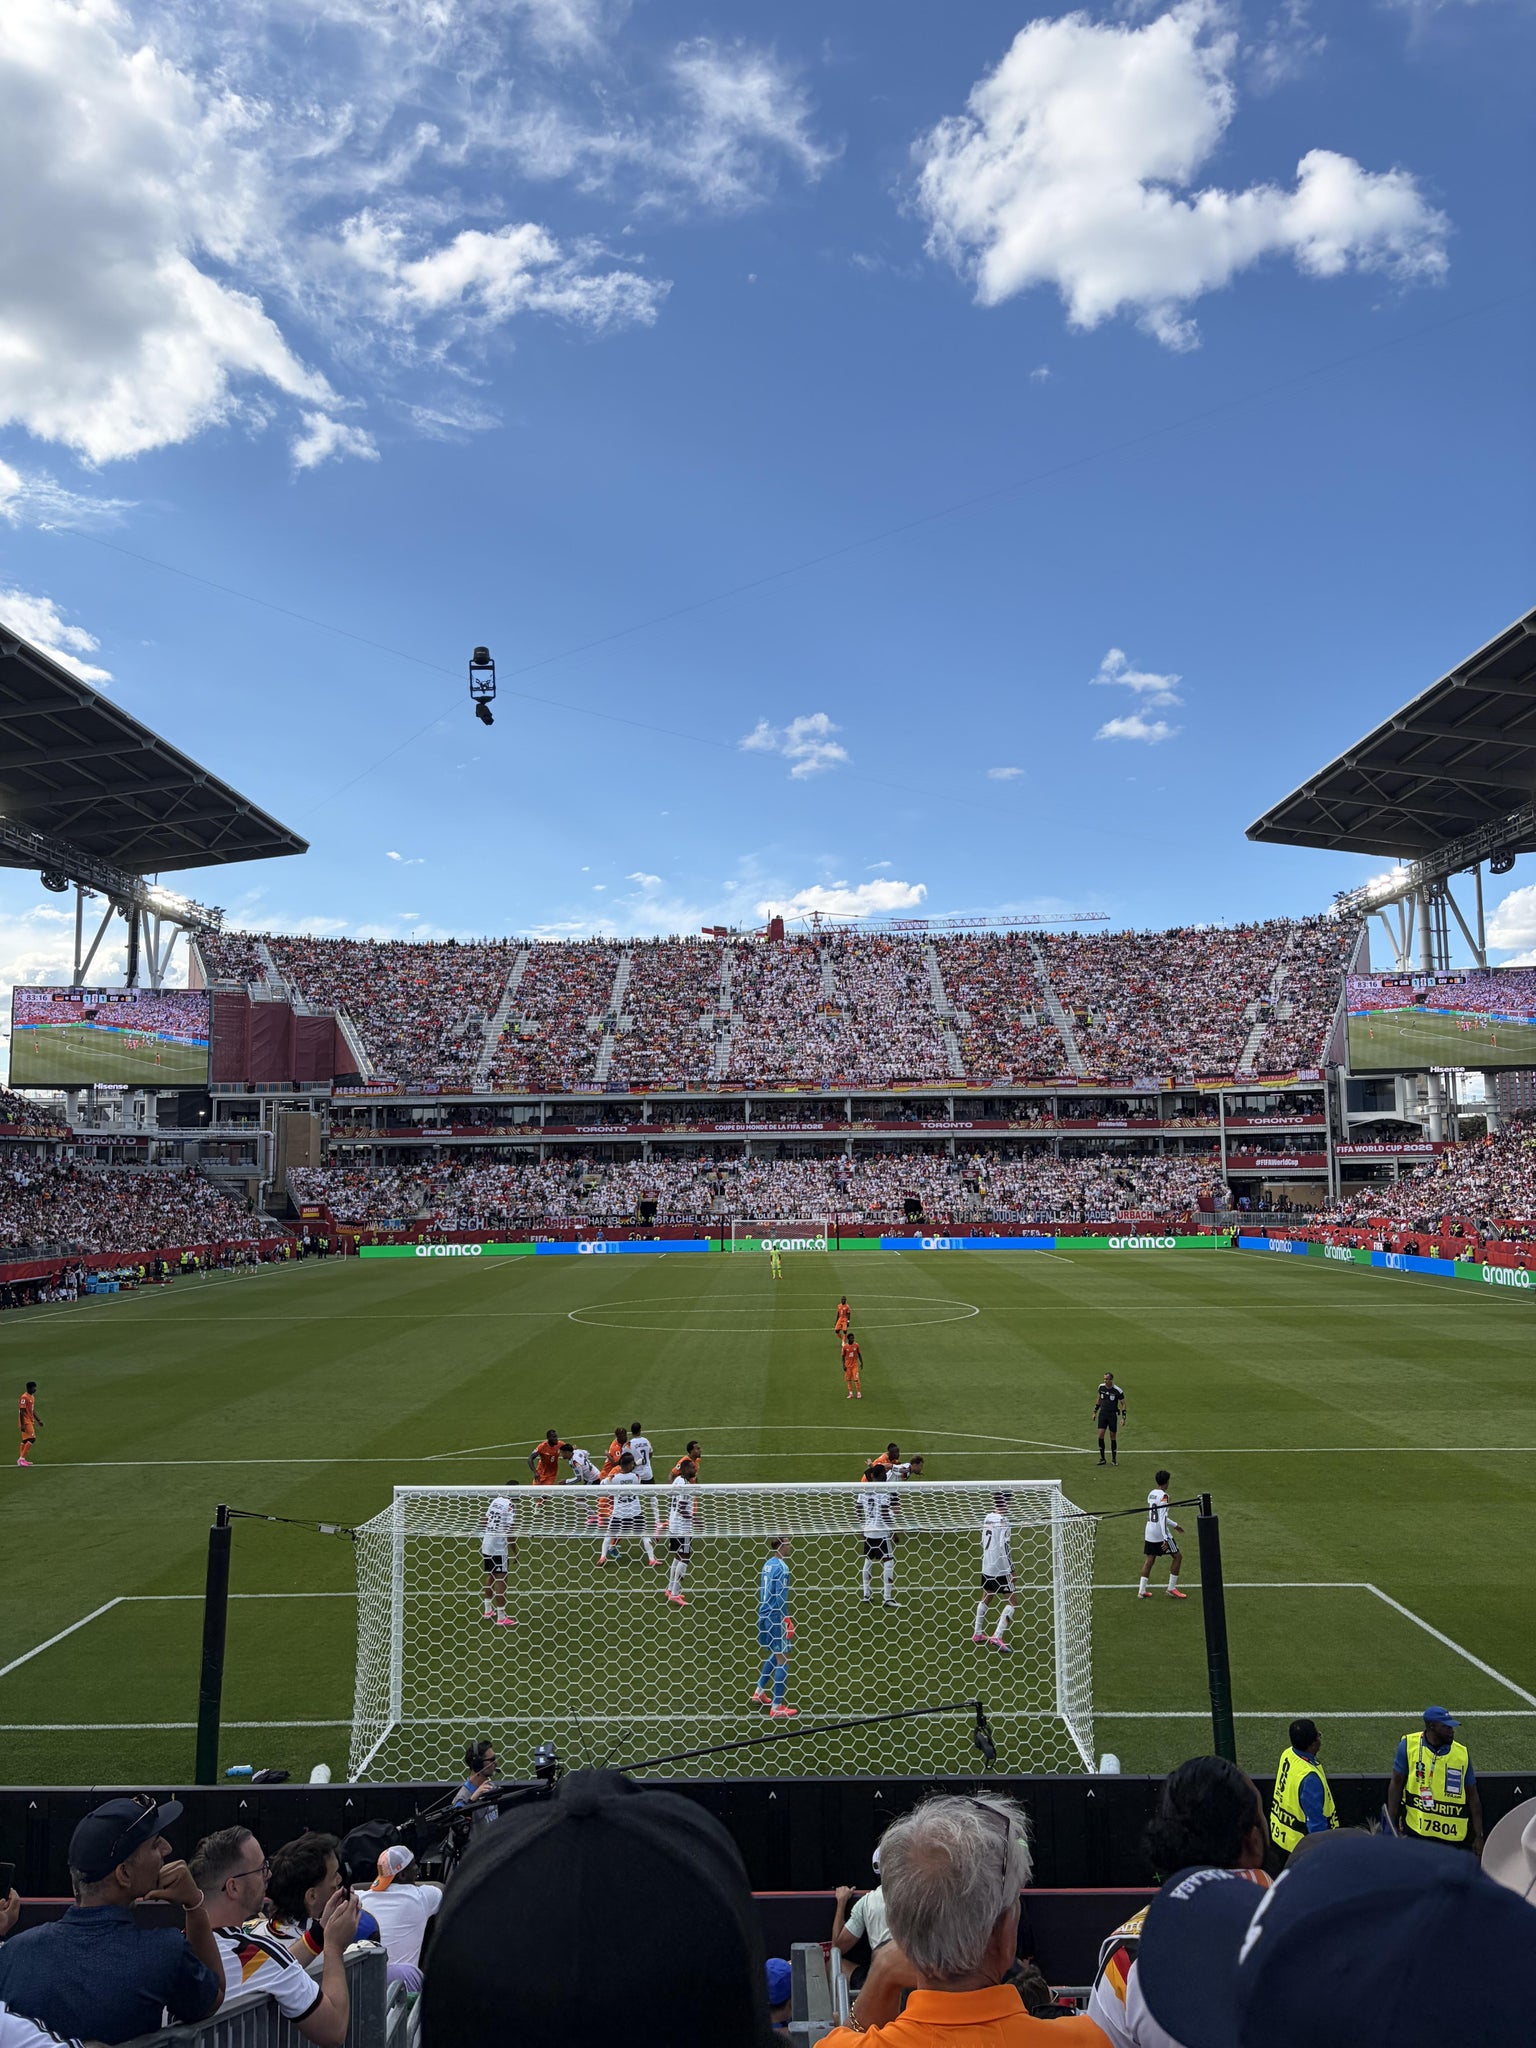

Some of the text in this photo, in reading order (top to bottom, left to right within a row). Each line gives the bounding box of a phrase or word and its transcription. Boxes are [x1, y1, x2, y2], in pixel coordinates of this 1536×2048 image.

[76, 1136, 136, 1144] TORONTO
[1117, 1211, 1153, 1220] URBACH
[761, 1239, 826, 1250] aramco
[1108, 1237, 1176, 1248] aramco
[1269, 1239, 1292, 1253] aramco
[416, 1245, 482, 1256] aramco
[1324, 1245, 1352, 1261] aramco
[1483, 1266, 1529, 1288] aramco
[985, 1530, 992, 1550] 7
